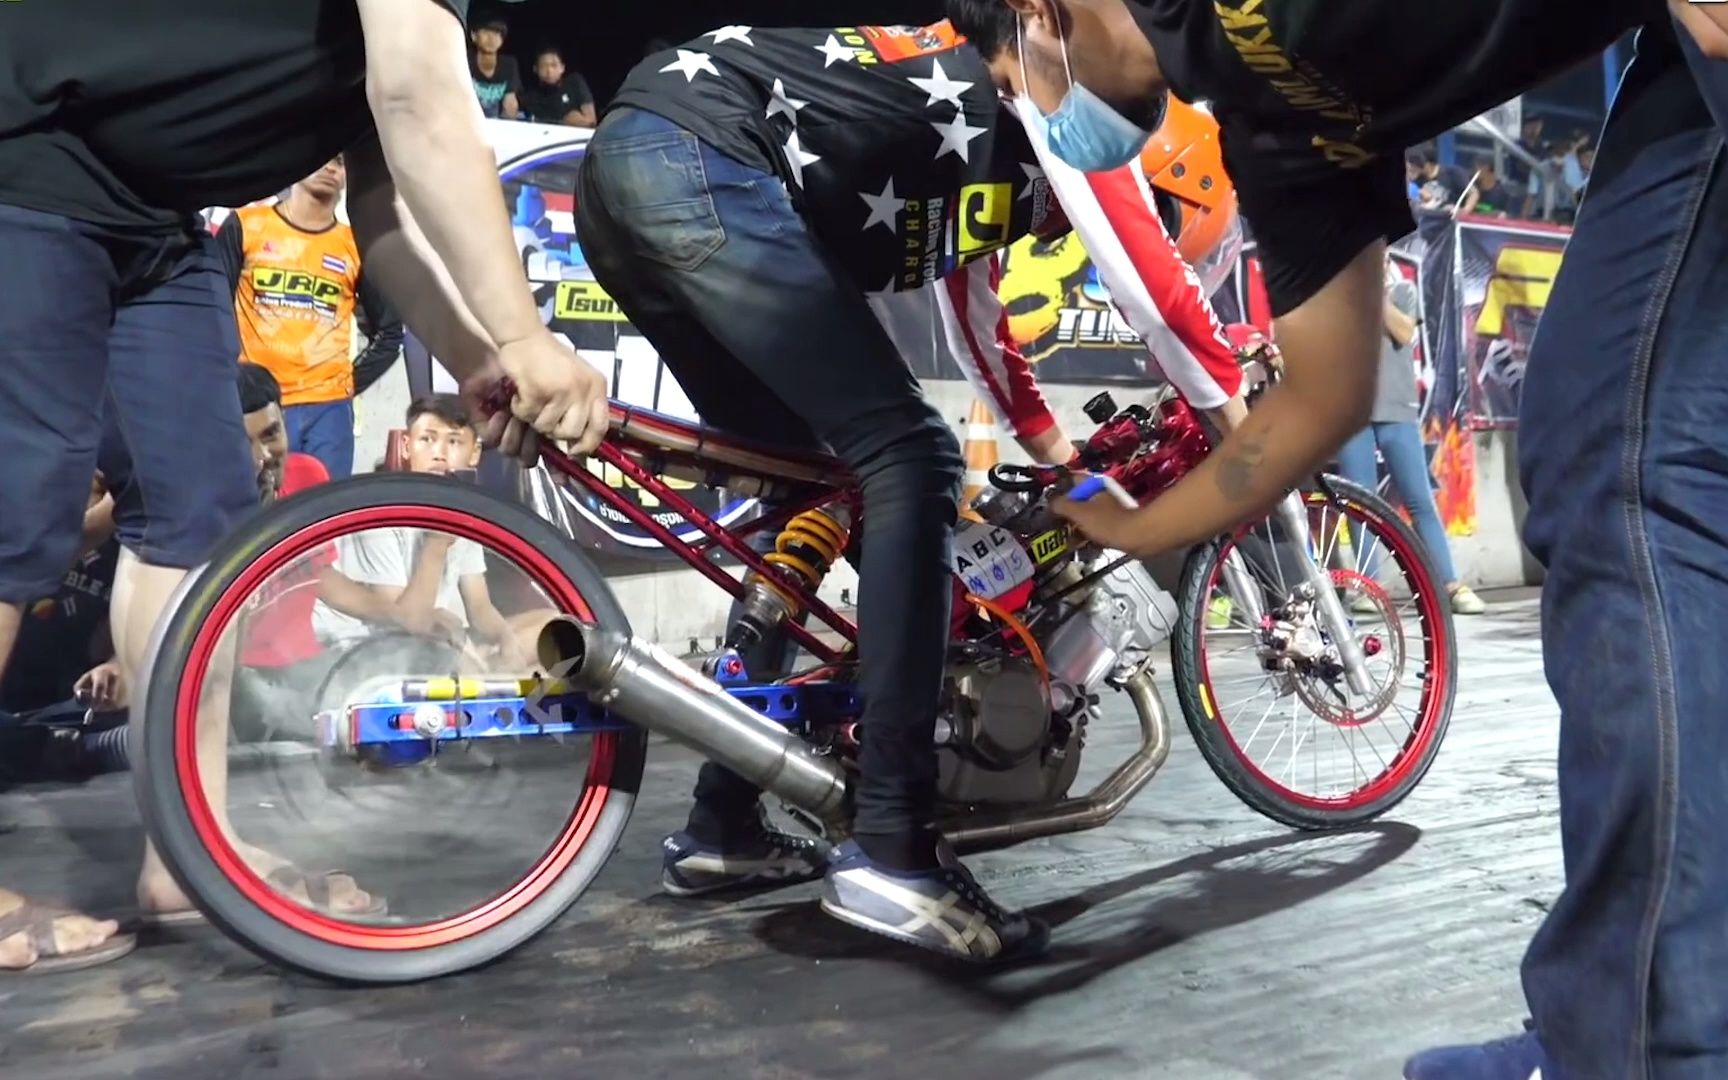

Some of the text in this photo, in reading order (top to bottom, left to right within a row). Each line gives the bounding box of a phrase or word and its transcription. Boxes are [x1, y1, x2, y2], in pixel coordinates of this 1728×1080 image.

[956, 528, 1006, 574] A B C
